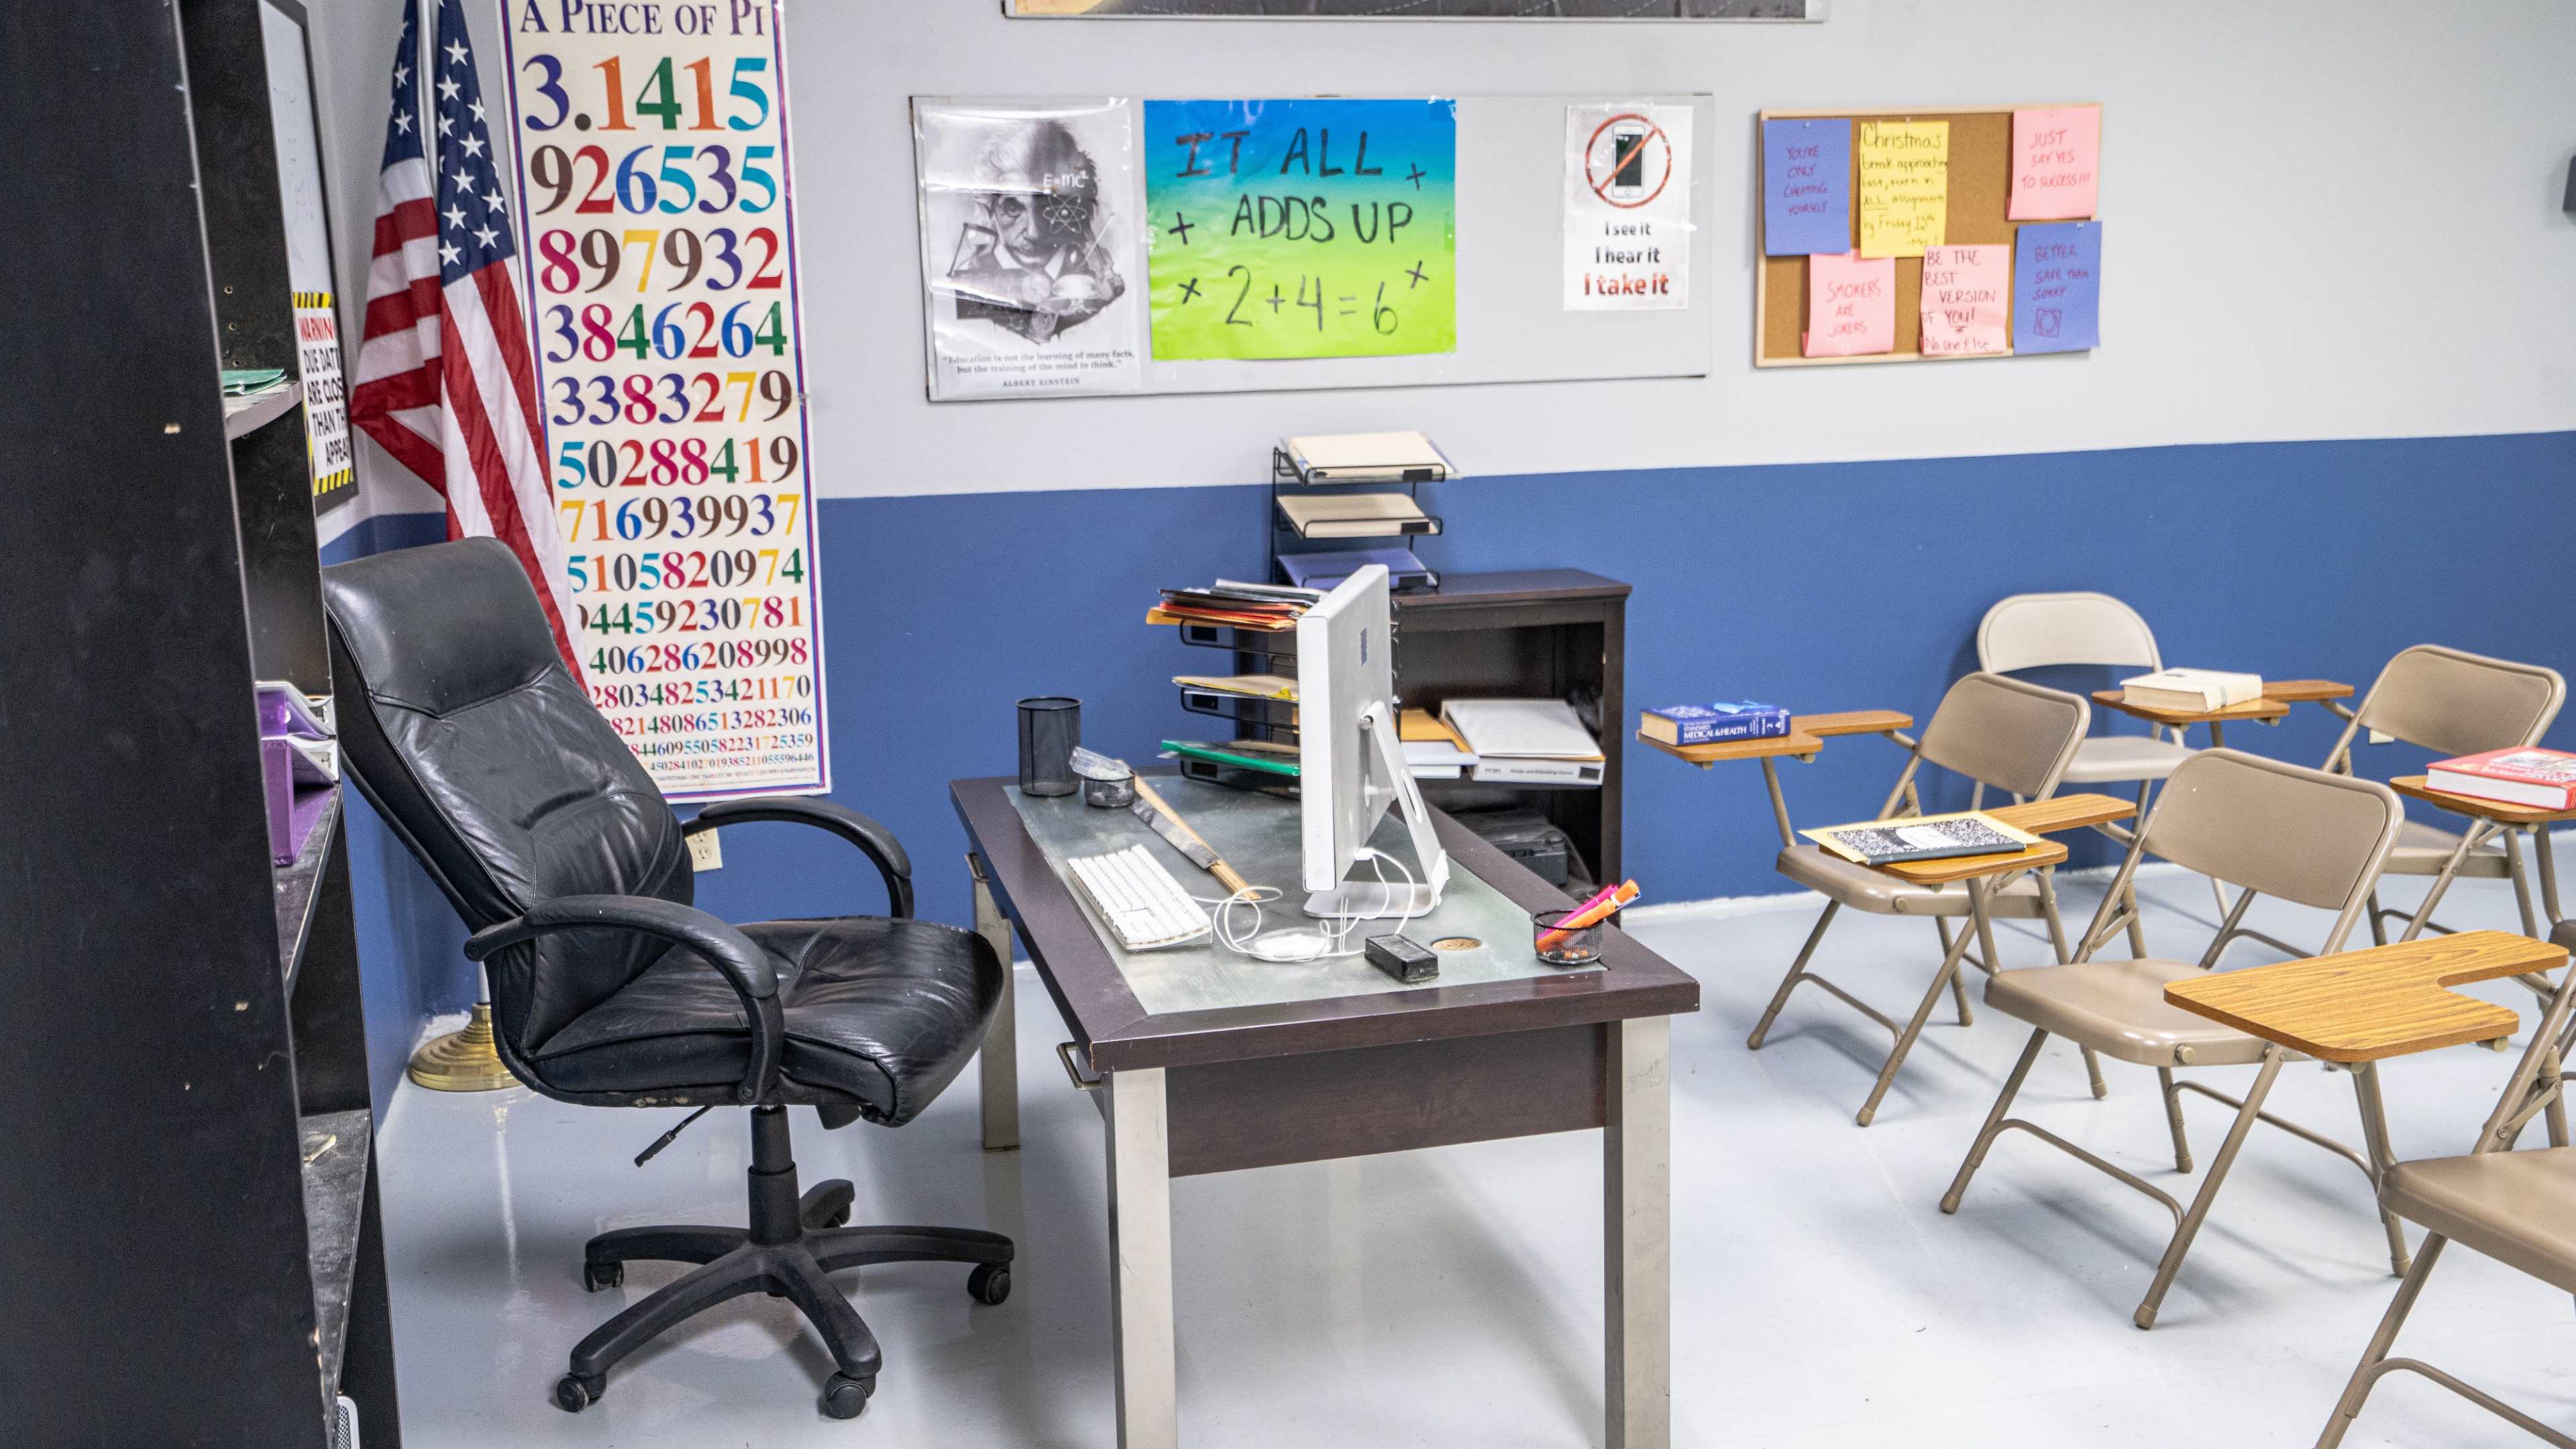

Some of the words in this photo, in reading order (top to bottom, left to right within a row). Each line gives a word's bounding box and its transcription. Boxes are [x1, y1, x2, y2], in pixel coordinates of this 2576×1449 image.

[521, 0, 549, 33] A
[561, 0, 663, 35] PIECE
[675, 5, 716, 35] OF
[731, 0, 764, 35] PI
[523, 54, 769, 131] 3.1415
[1864, 123, 1941, 149] Christmas
[2030, 127, 2068, 149] JUST
[1175, 130, 1250, 178] IT
[1280, 127, 1383, 178] ALL
[2031, 150, 2053, 168] SAY
[2055, 150, 2075, 164] YES
[531, 145, 776, 215] 926535
[1230, 193, 1335, 243] ADDS
[1351, 201, 1413, 244] UP
[1613, 224, 1636, 236] see
[1640, 221, 1651, 236] it
[1879, 213, 1911, 236] Friday
[539, 227, 784, 294] 897932
[1605, 246, 1643, 264] hear
[1648, 246, 1660, 264] it
[1927, 251, 1943, 267] BE
[1953, 250, 1982, 267] THE
[1597, 272, 1647, 297] take
[1652, 272, 1669, 296] it
[1826, 278, 1882, 304] SMOKERS
[1925, 271, 1960, 287] BEST
[1938, 288, 1997, 304] VERSION
[1835, 303, 1856, 319] ARE
[1944, 307, 1975, 327] YOU!
[545, 301, 788, 363] 3846264
[957, 366, 971, 374] but
[974, 365, 987, 374] the
[990, 364, 1026, 373] training
[1027, 363, 1037, 371] of
[1039, 362, 1053, 370] the
[1055, 362, 1077, 370] mind
[1079, 362, 1089, 370] to
[994, 354, 1002, 362] is
[1004, 354, 1018, 362] not
[1036, 352, 1073, 361] learning
[1075, 351, 1084, 359] of
[1086, 351, 1110, 359] many
[307, 380, 323, 406] ARE
[1002, 379, 1035, 387] ALBERT
[1039, 378, 1079, 386] EINSTEIN
[551, 370, 792, 426] 3383279
[312, 409, 336, 437] THAN
[558, 436, 798, 489] 50288419
[559, 494, 801, 543] 716939937
[568, 548, 804, 593] 5105820974
